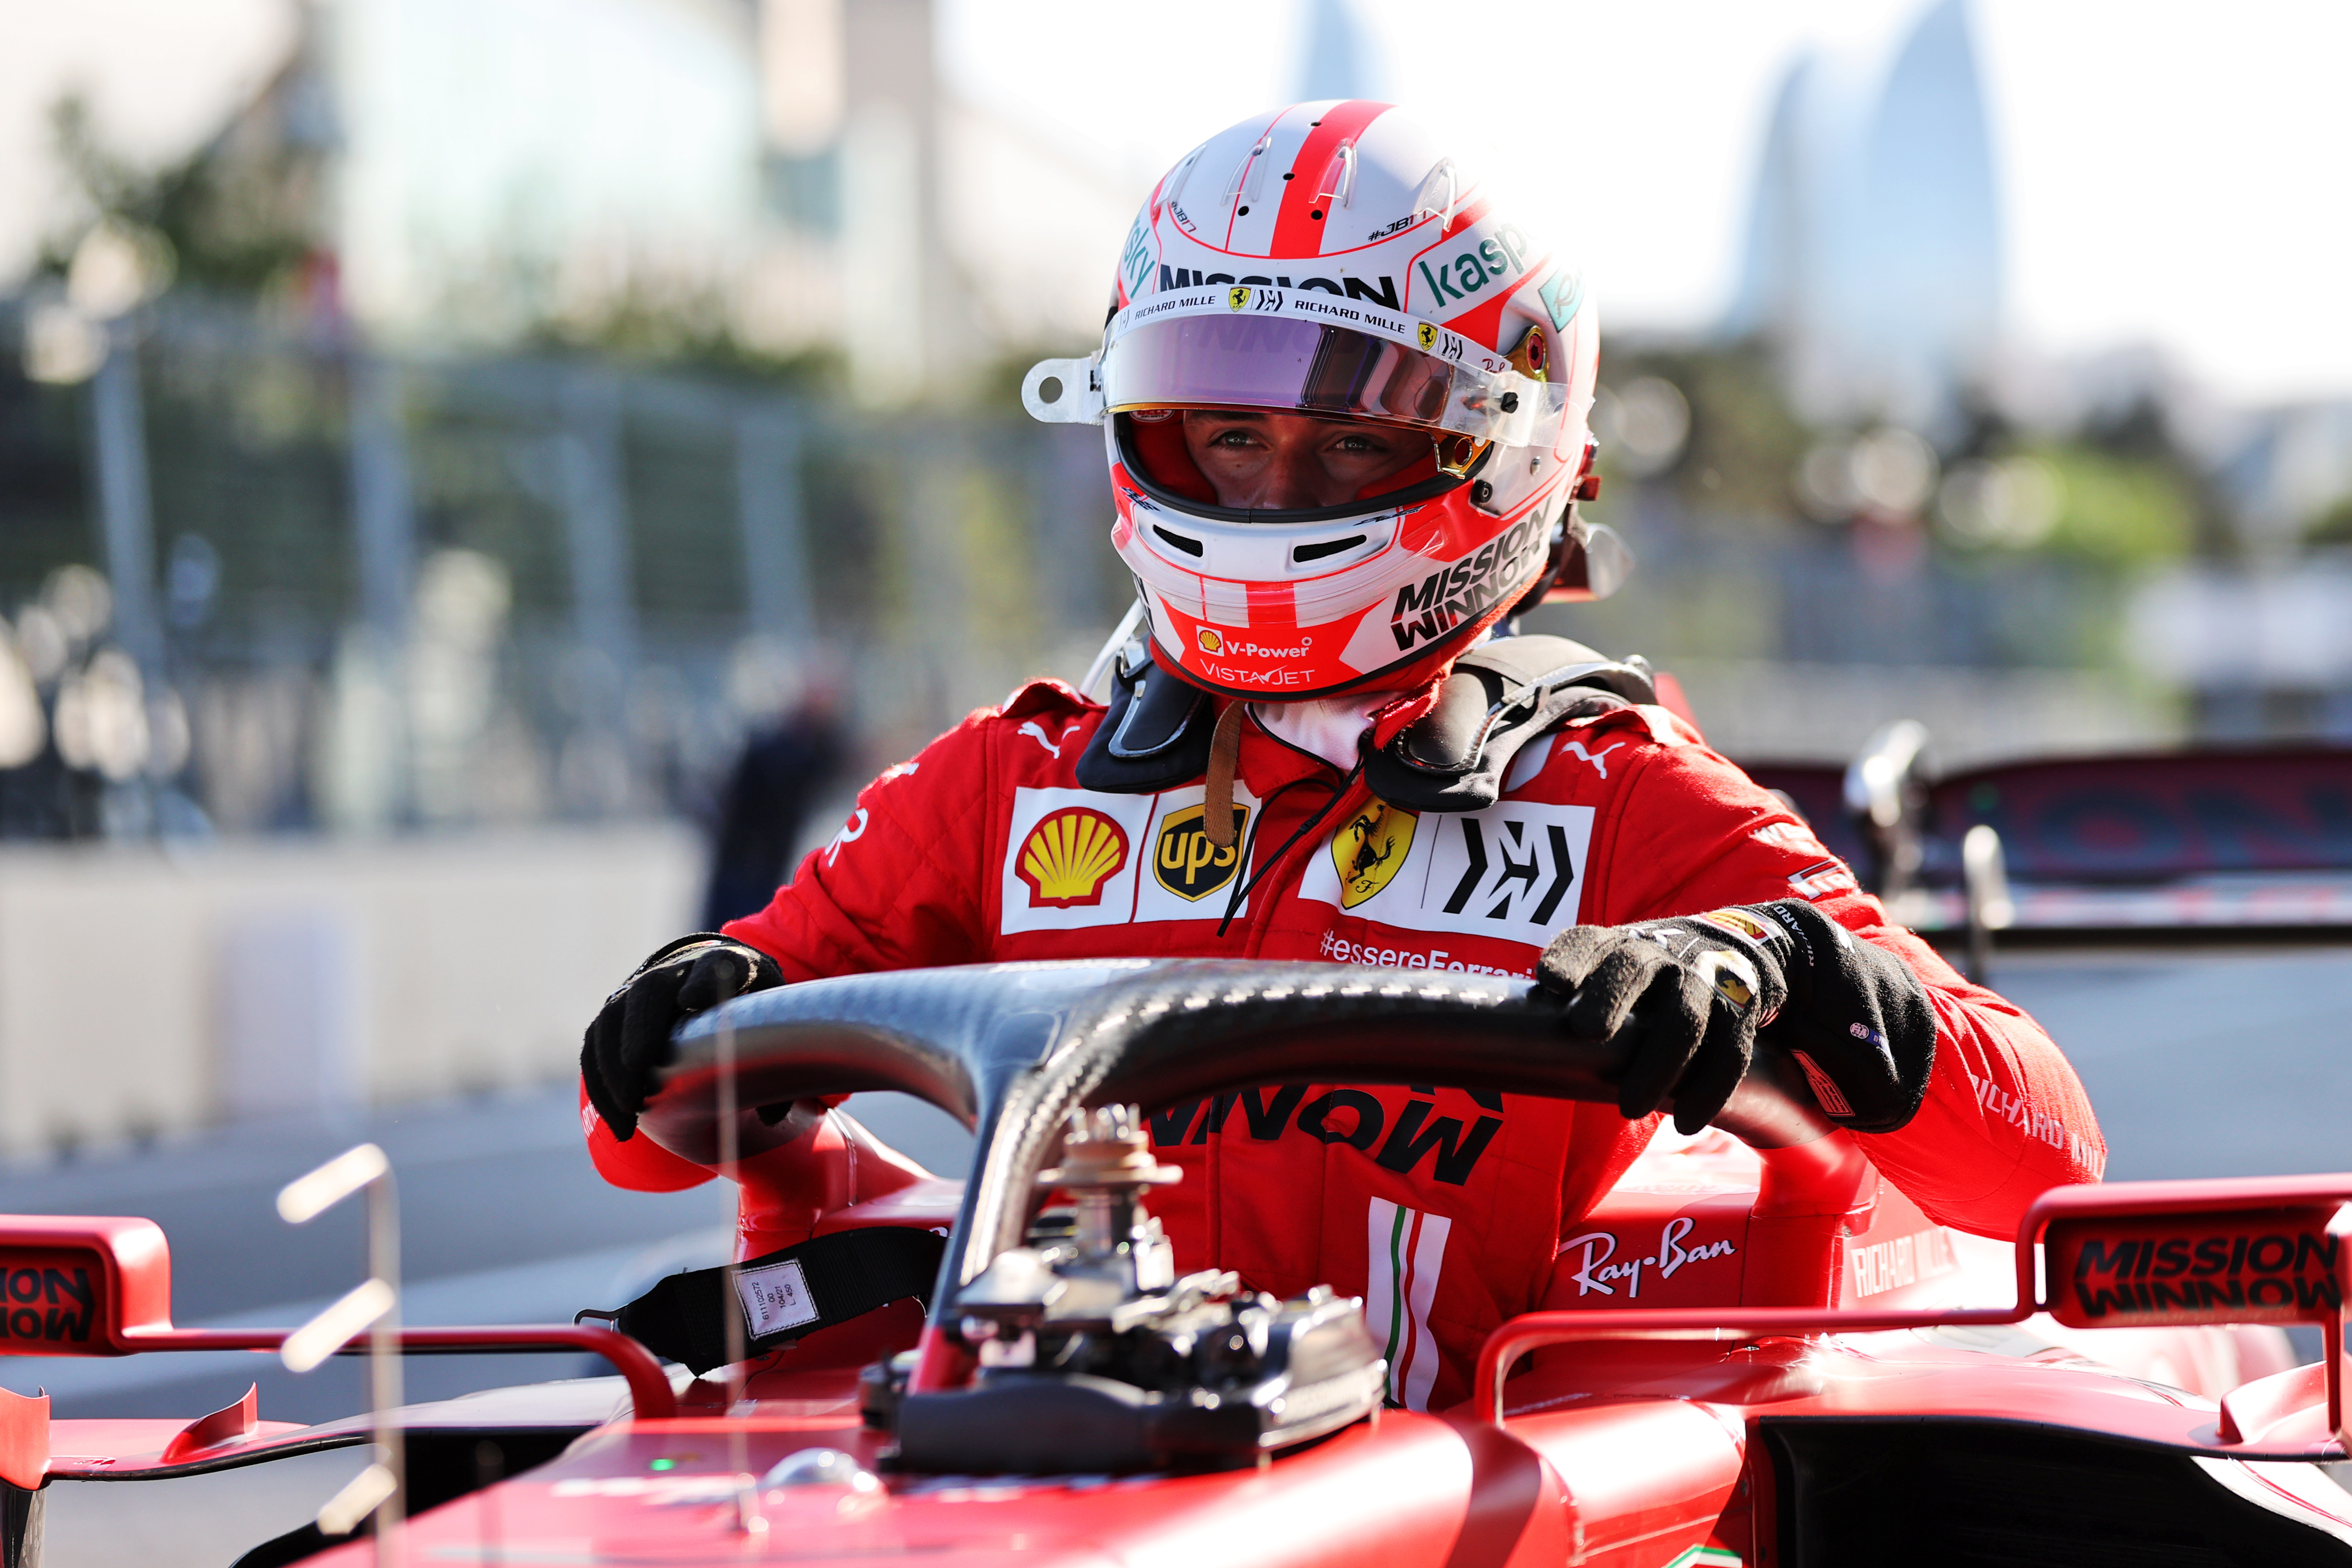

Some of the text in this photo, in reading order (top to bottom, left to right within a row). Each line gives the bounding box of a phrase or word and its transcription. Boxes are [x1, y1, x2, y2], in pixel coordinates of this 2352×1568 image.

[1170, 201, 1197, 233] #JB17
[1418, 223, 1529, 308] kasp
[1134, 296, 1216, 320] RICHARD MILLE
[1294, 300, 1406, 334] RICHARD MILLE
[1390, 494, 1553, 624] MISSION
[1390, 532, 1543, 652] WINNOW
[1225, 640, 1310, 658] V-Power
[1161, 830, 1237, 885] ups
[2073, 1232, 2339, 1280] MISSION
[752, 1281, 769, 1320] 611102572
[767, 1293, 775, 1303] 00
[784, 1284, 793, 1297] 450
[2073, 1273, 2344, 1317] WINNOW
